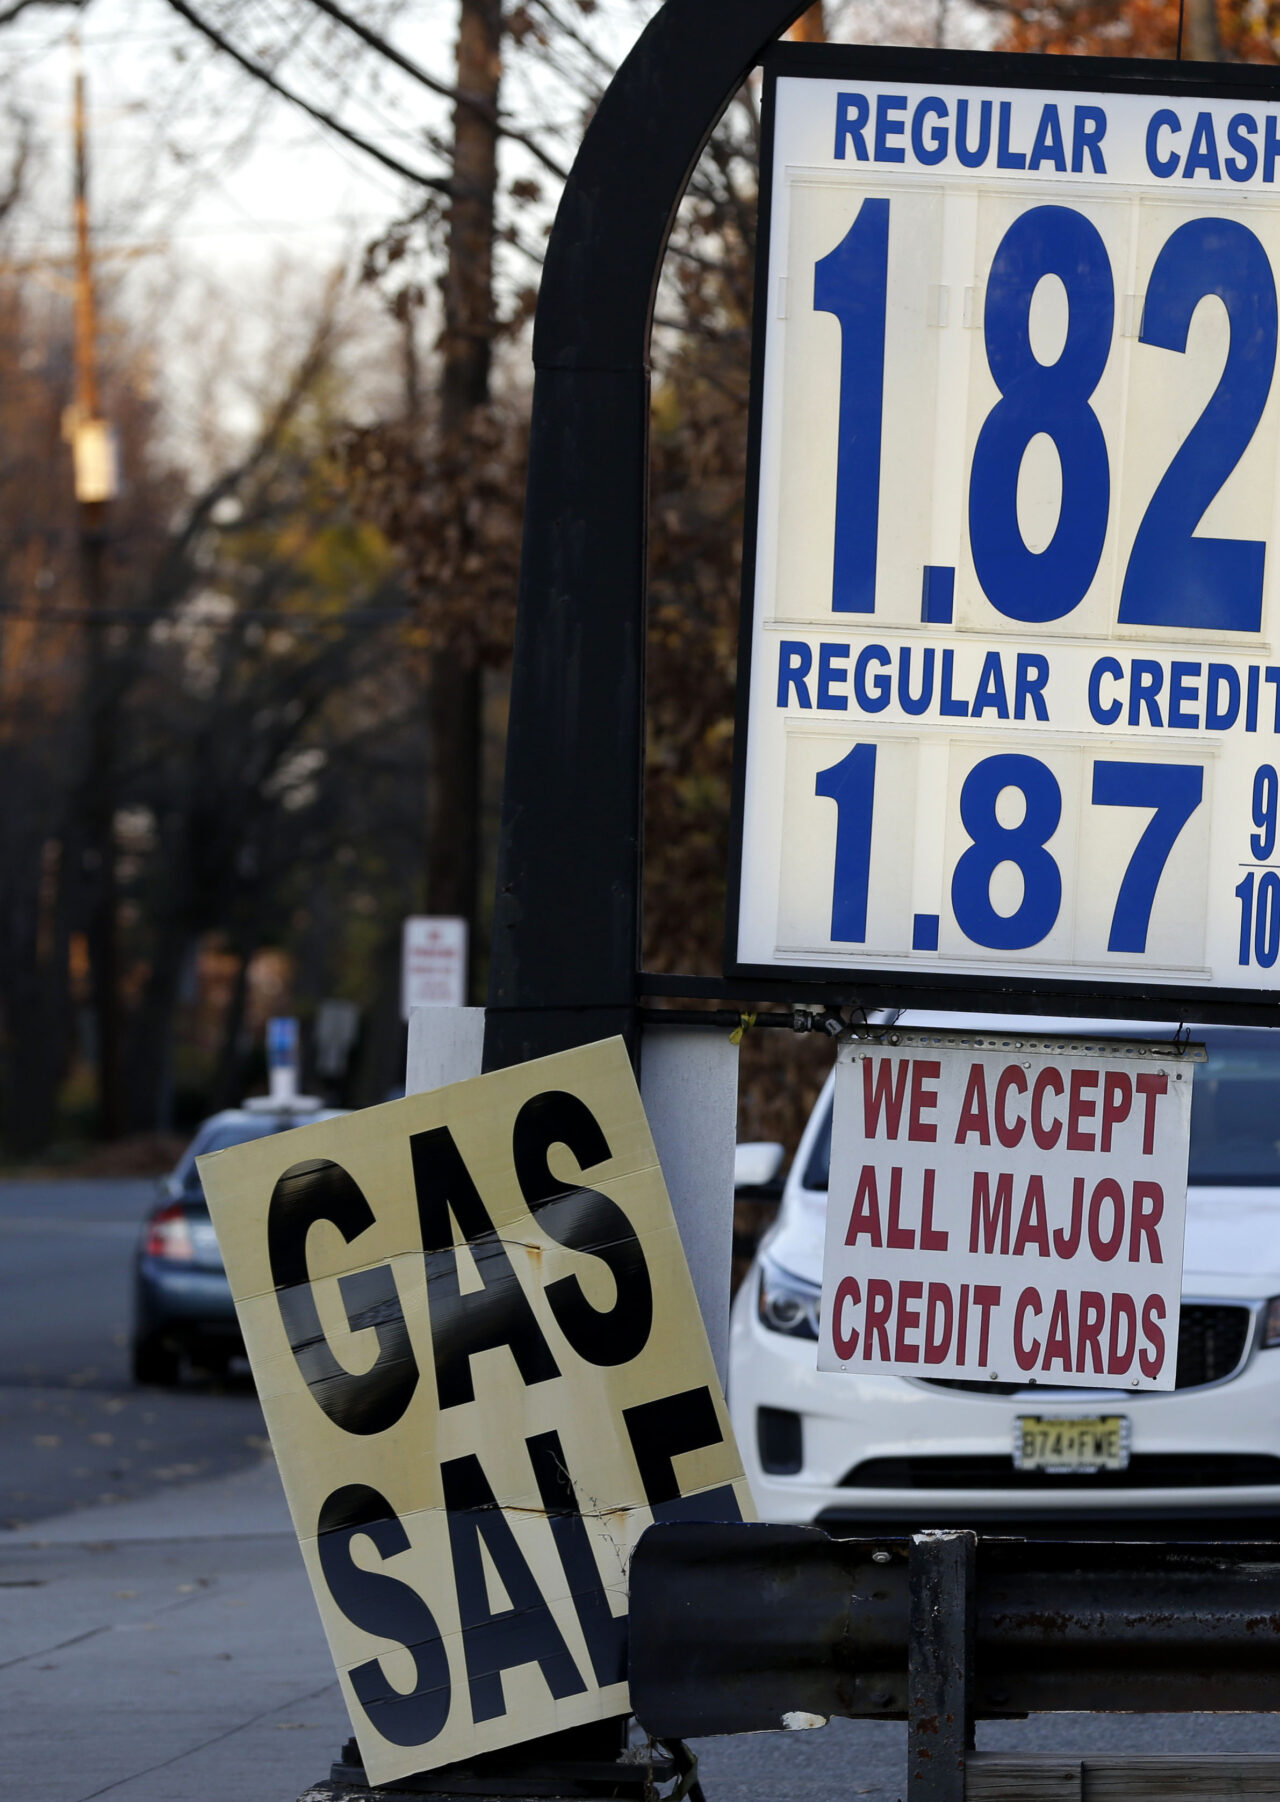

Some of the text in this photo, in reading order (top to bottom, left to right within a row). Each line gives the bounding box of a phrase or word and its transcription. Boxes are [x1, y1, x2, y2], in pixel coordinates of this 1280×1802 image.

[834, 91, 1108, 175] REGULAR
[813, 197, 1278, 633] 1.82
[777, 640, 1049, 721] REGULAR
[815, 743, 1204, 953] 1.87
[1250, 764, 1279, 861] 9
[862, 1056, 1169, 1155] WE ACCEPT
[267, 1090, 653, 1436] GAS
[844, 1164, 1164, 1264] ALL MAJOR
[832, 1276, 1167, 1379] CREDIT CARDS
